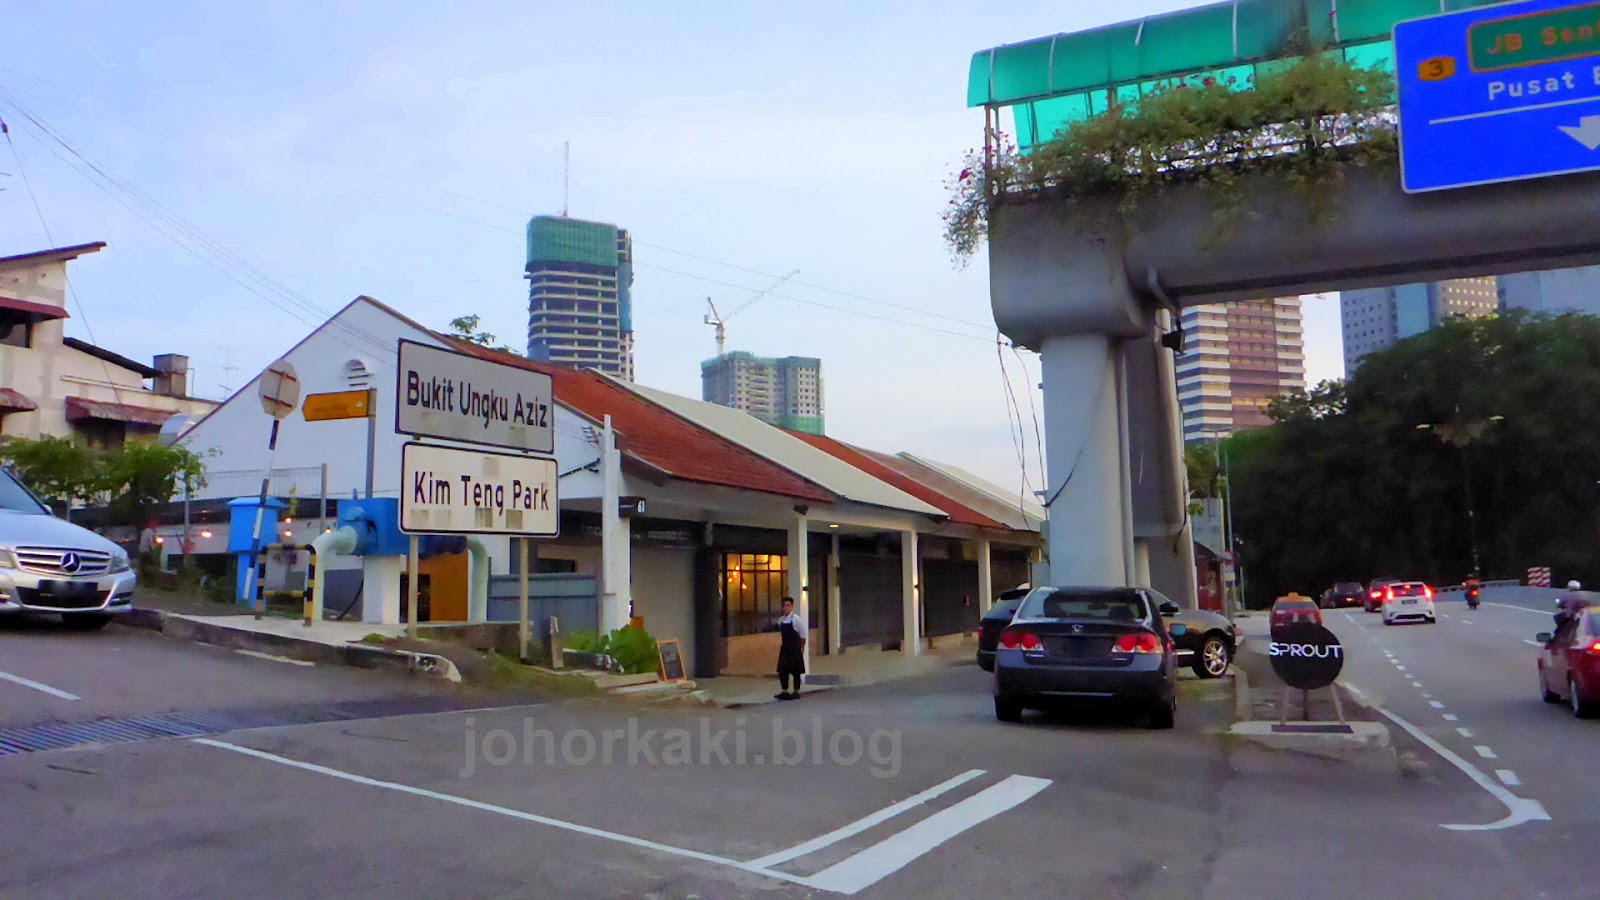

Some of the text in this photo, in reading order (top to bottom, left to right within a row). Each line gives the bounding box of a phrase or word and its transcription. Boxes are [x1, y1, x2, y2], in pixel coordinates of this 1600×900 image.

[1486, 22, 1600, 55] JB Sen
[1429, 60, 1444, 77] 3
[1487, 71, 1575, 101] Pusat
[407, 370, 548, 430] Bukit Ungku Aziz
[414, 471, 549, 516] Kim Teng Park
[637, 500, 645, 513] 61
[1269, 642, 1342, 658] SPROUT
